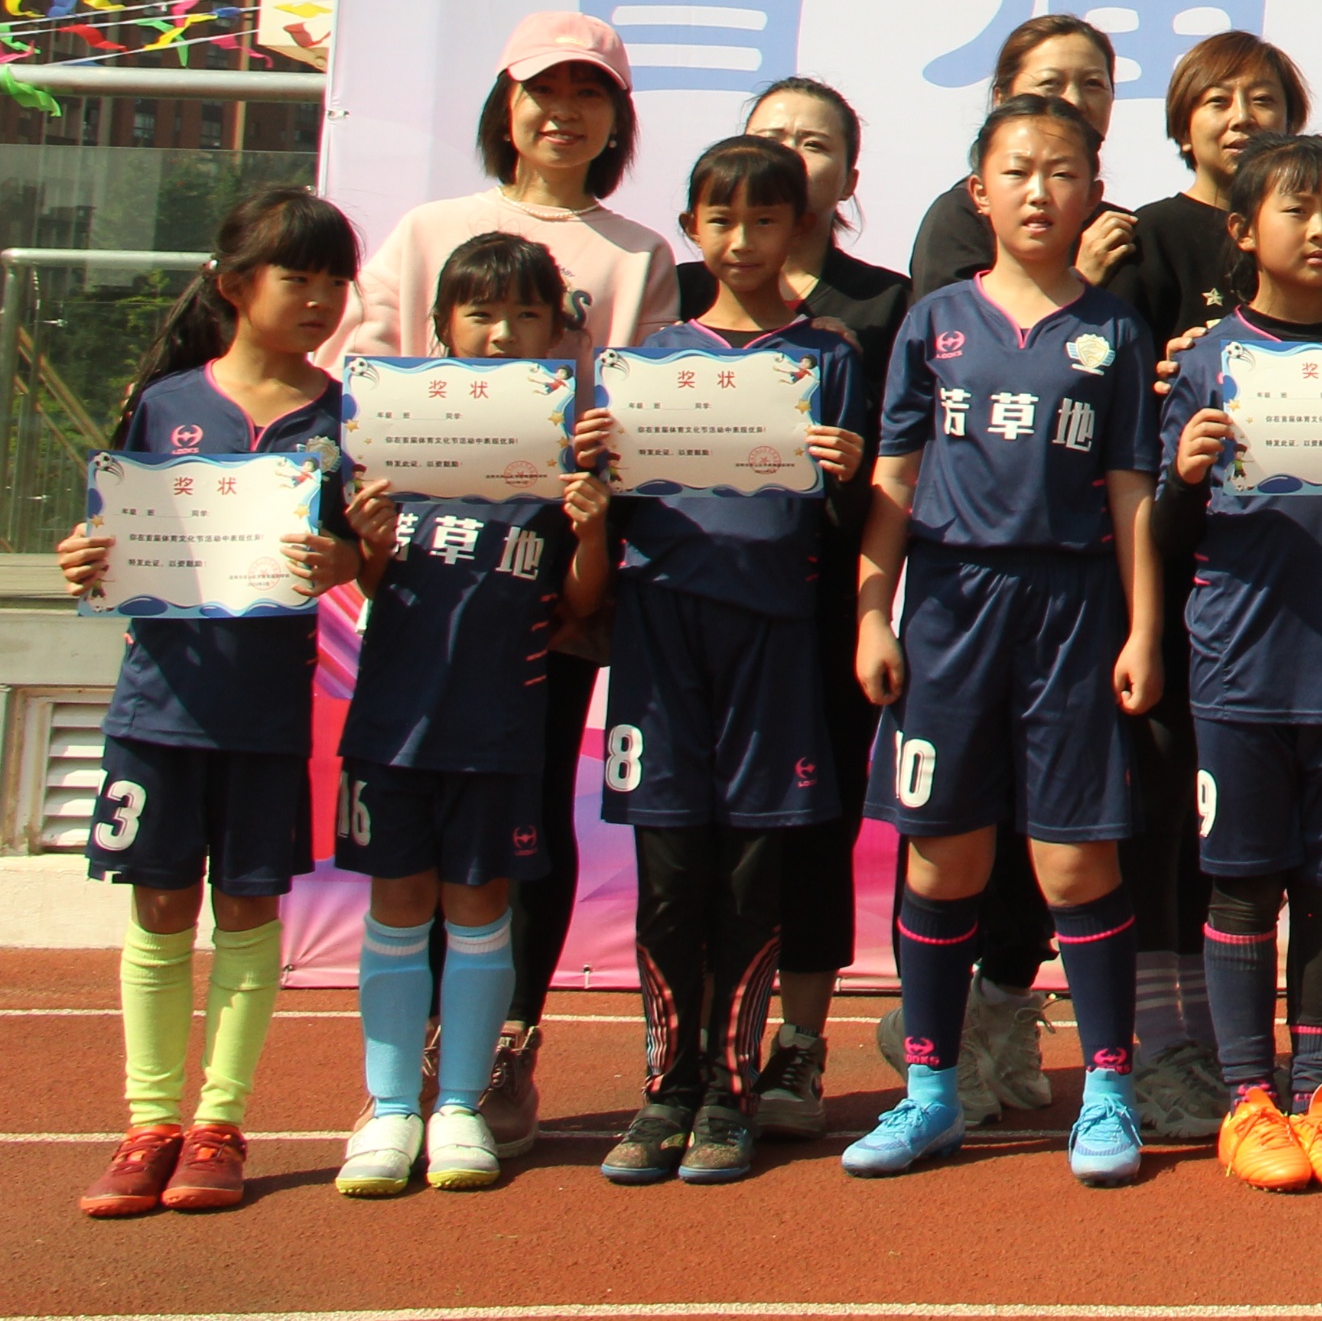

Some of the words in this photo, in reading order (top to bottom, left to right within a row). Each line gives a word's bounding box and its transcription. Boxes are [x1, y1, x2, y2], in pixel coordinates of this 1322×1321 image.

[429, 380, 488, 399] 奖状
[677, 371, 736, 389] 奖状
[940, 387, 1095, 452] 芳草地
[174, 478, 236, 496] 奖状
[606, 724, 643, 793] 8
[895, 730, 936, 808] 0
[94, 780, 148, 851] 3
